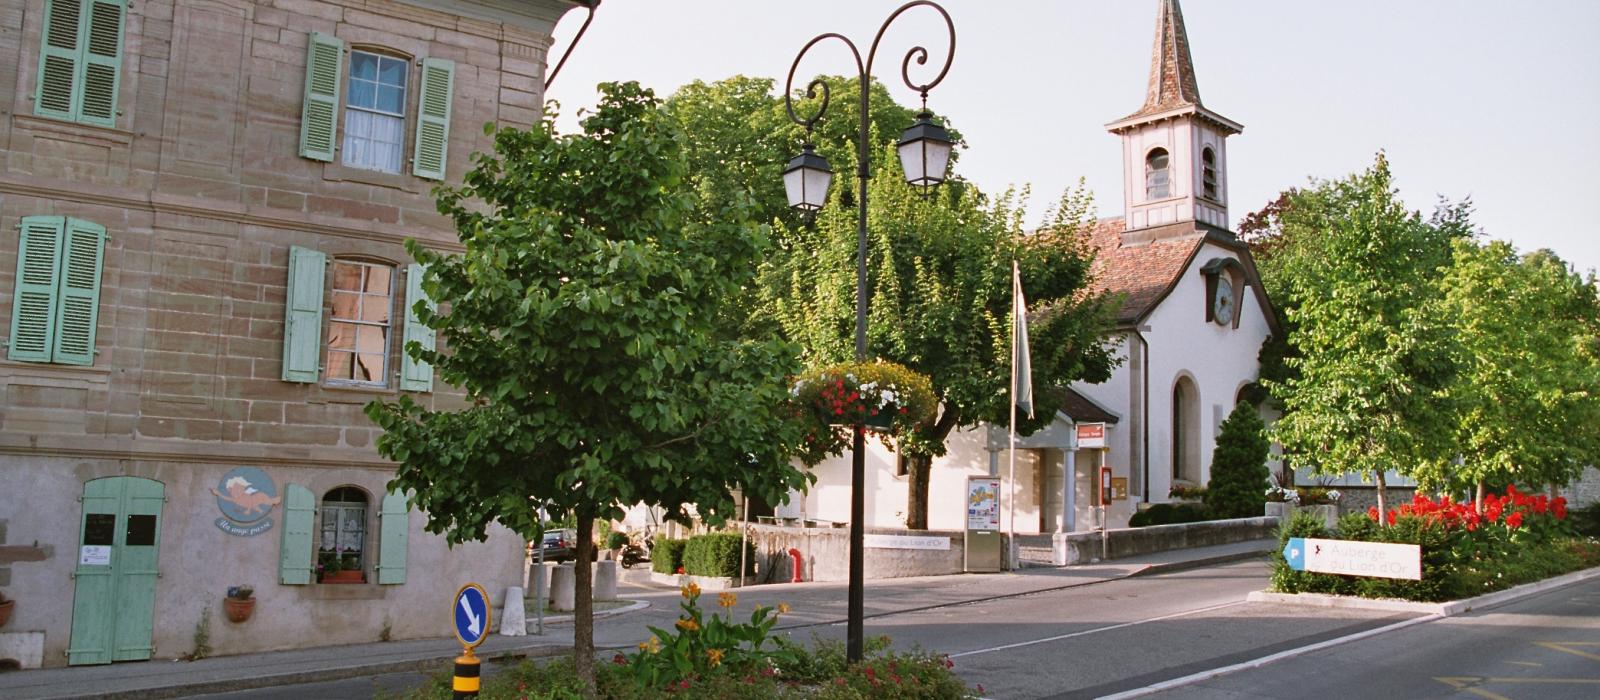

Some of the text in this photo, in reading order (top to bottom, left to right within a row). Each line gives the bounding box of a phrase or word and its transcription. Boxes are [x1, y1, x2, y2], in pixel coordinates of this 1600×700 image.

[231, 527, 249, 536] ange
[1291, 549, 1299, 559] P
[1331, 545, 1386, 561] Auberge
[1330, 559, 1408, 574] du Lion d'Or
